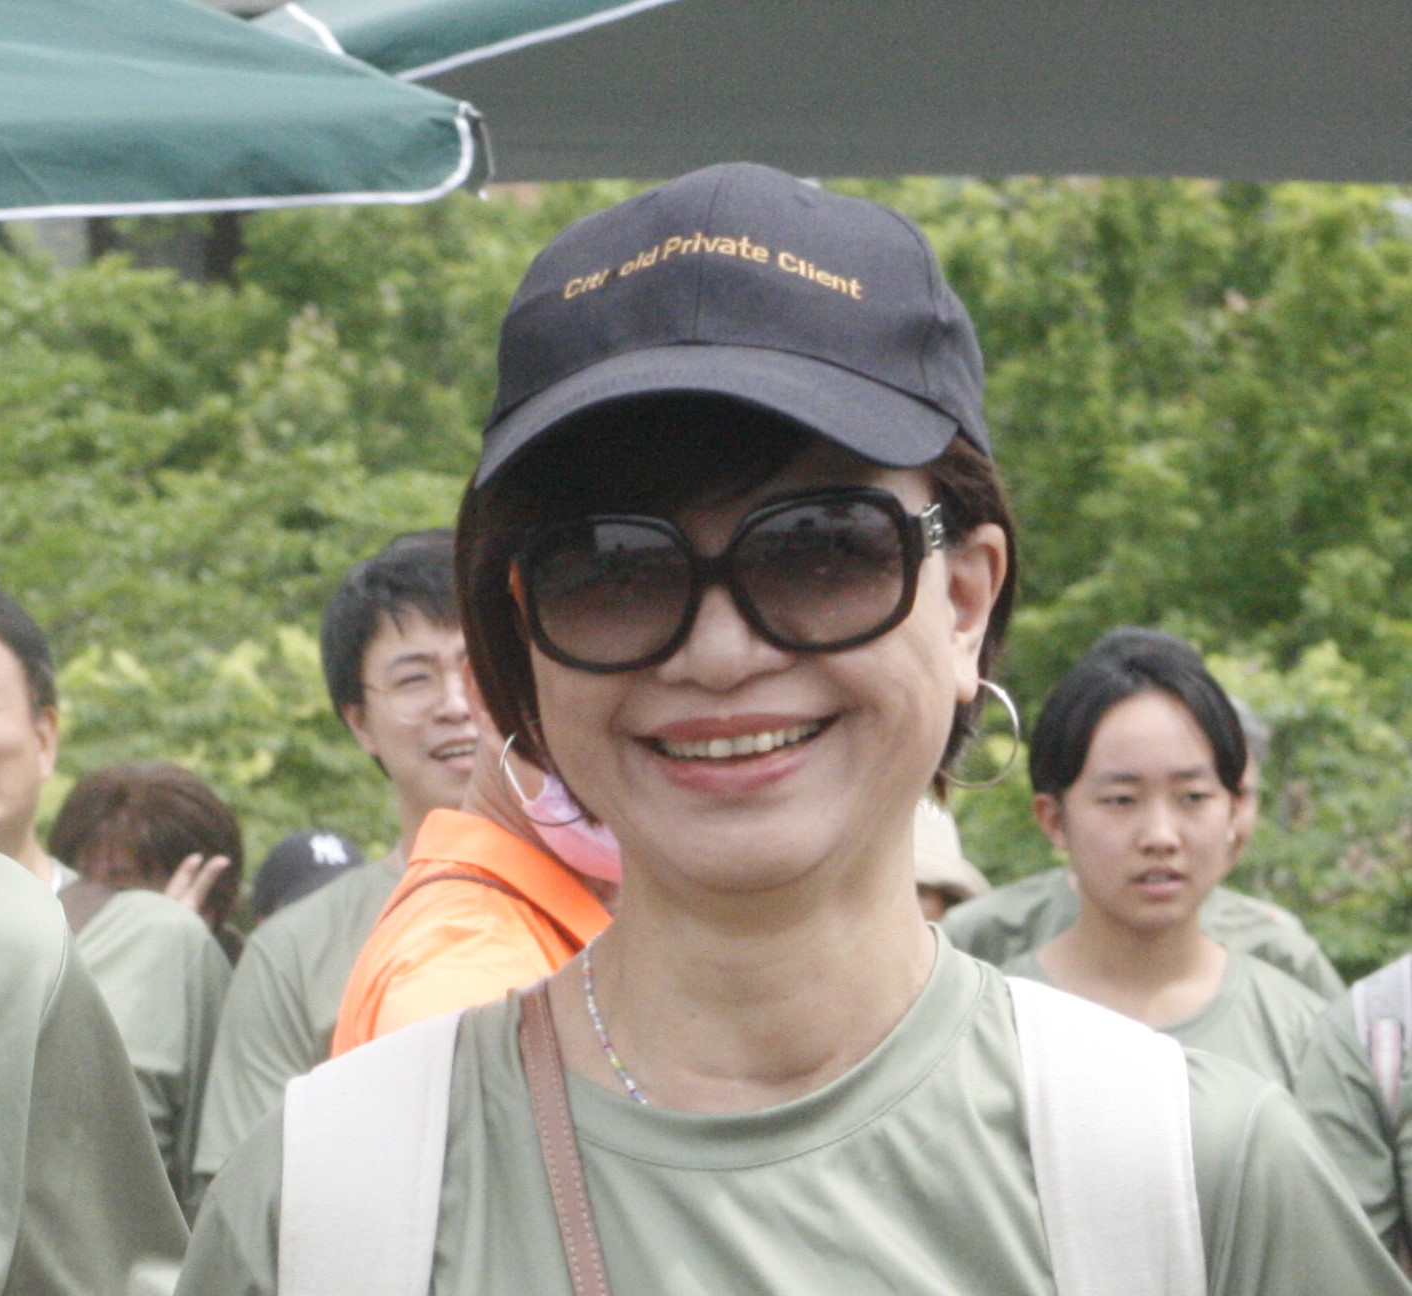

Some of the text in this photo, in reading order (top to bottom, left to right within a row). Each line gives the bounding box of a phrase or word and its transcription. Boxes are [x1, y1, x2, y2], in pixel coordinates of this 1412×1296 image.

[563, 231, 864, 300] Citiold Private Client
